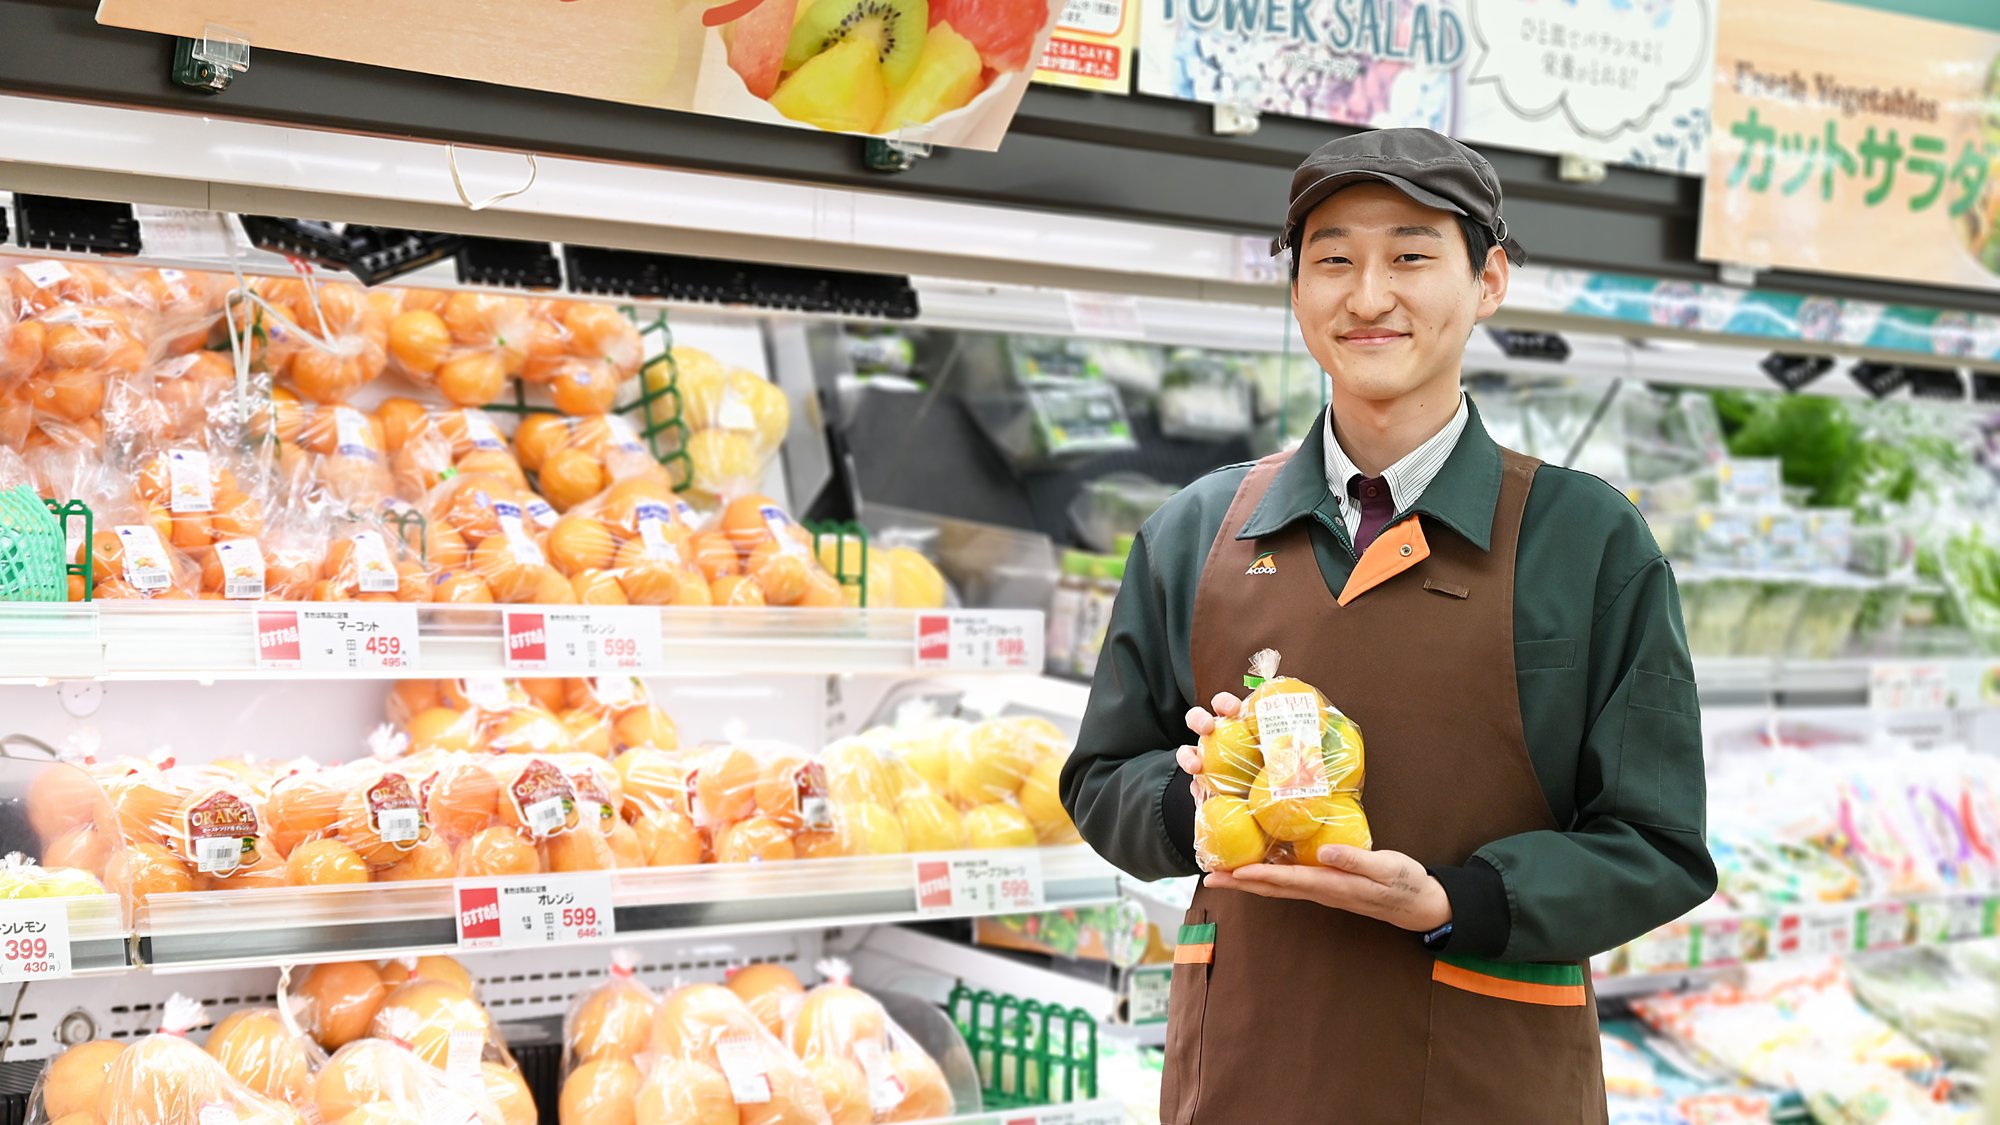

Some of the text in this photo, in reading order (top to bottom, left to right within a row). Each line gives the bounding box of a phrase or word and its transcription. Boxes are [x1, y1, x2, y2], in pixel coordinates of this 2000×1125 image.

[1164, 0, 1466, 64] OWER SALAD
[1735, 60, 1939, 123] Fresh Vegetables
[337, 621, 379, 632] マーコット
[191, 807, 256, 827] ORANGE
[538, 892, 574, 906] オレンジ
[0, 921, 46, 935] ンレモン
